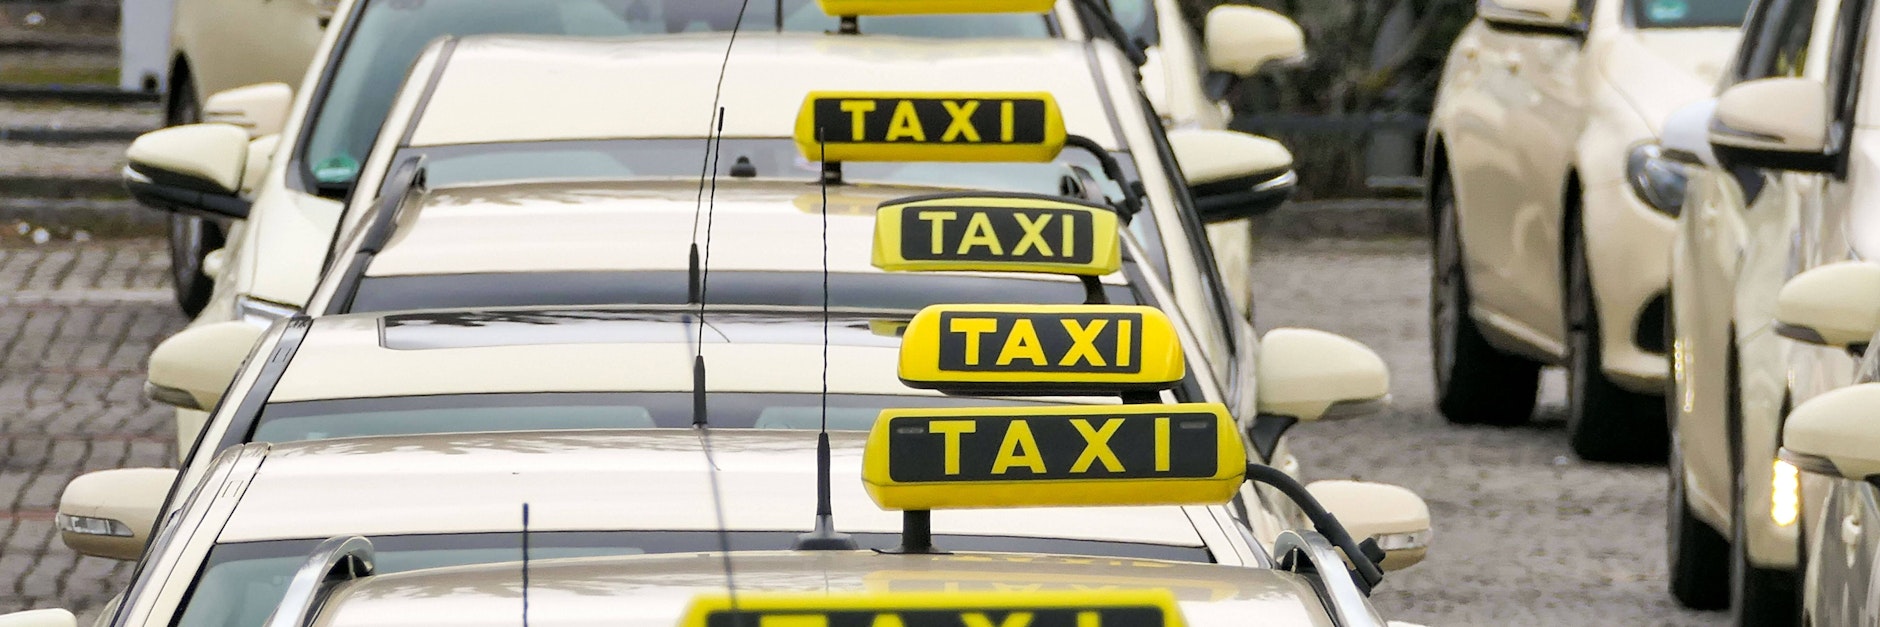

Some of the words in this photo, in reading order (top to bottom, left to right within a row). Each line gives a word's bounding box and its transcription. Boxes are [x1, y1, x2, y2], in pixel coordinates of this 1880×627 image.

[841, 99, 1014, 142] TAXI
[920, 210, 1075, 258] TAXI
[949, 317, 1132, 367] TAXI
[928, 417, 1171, 475] TAXI
